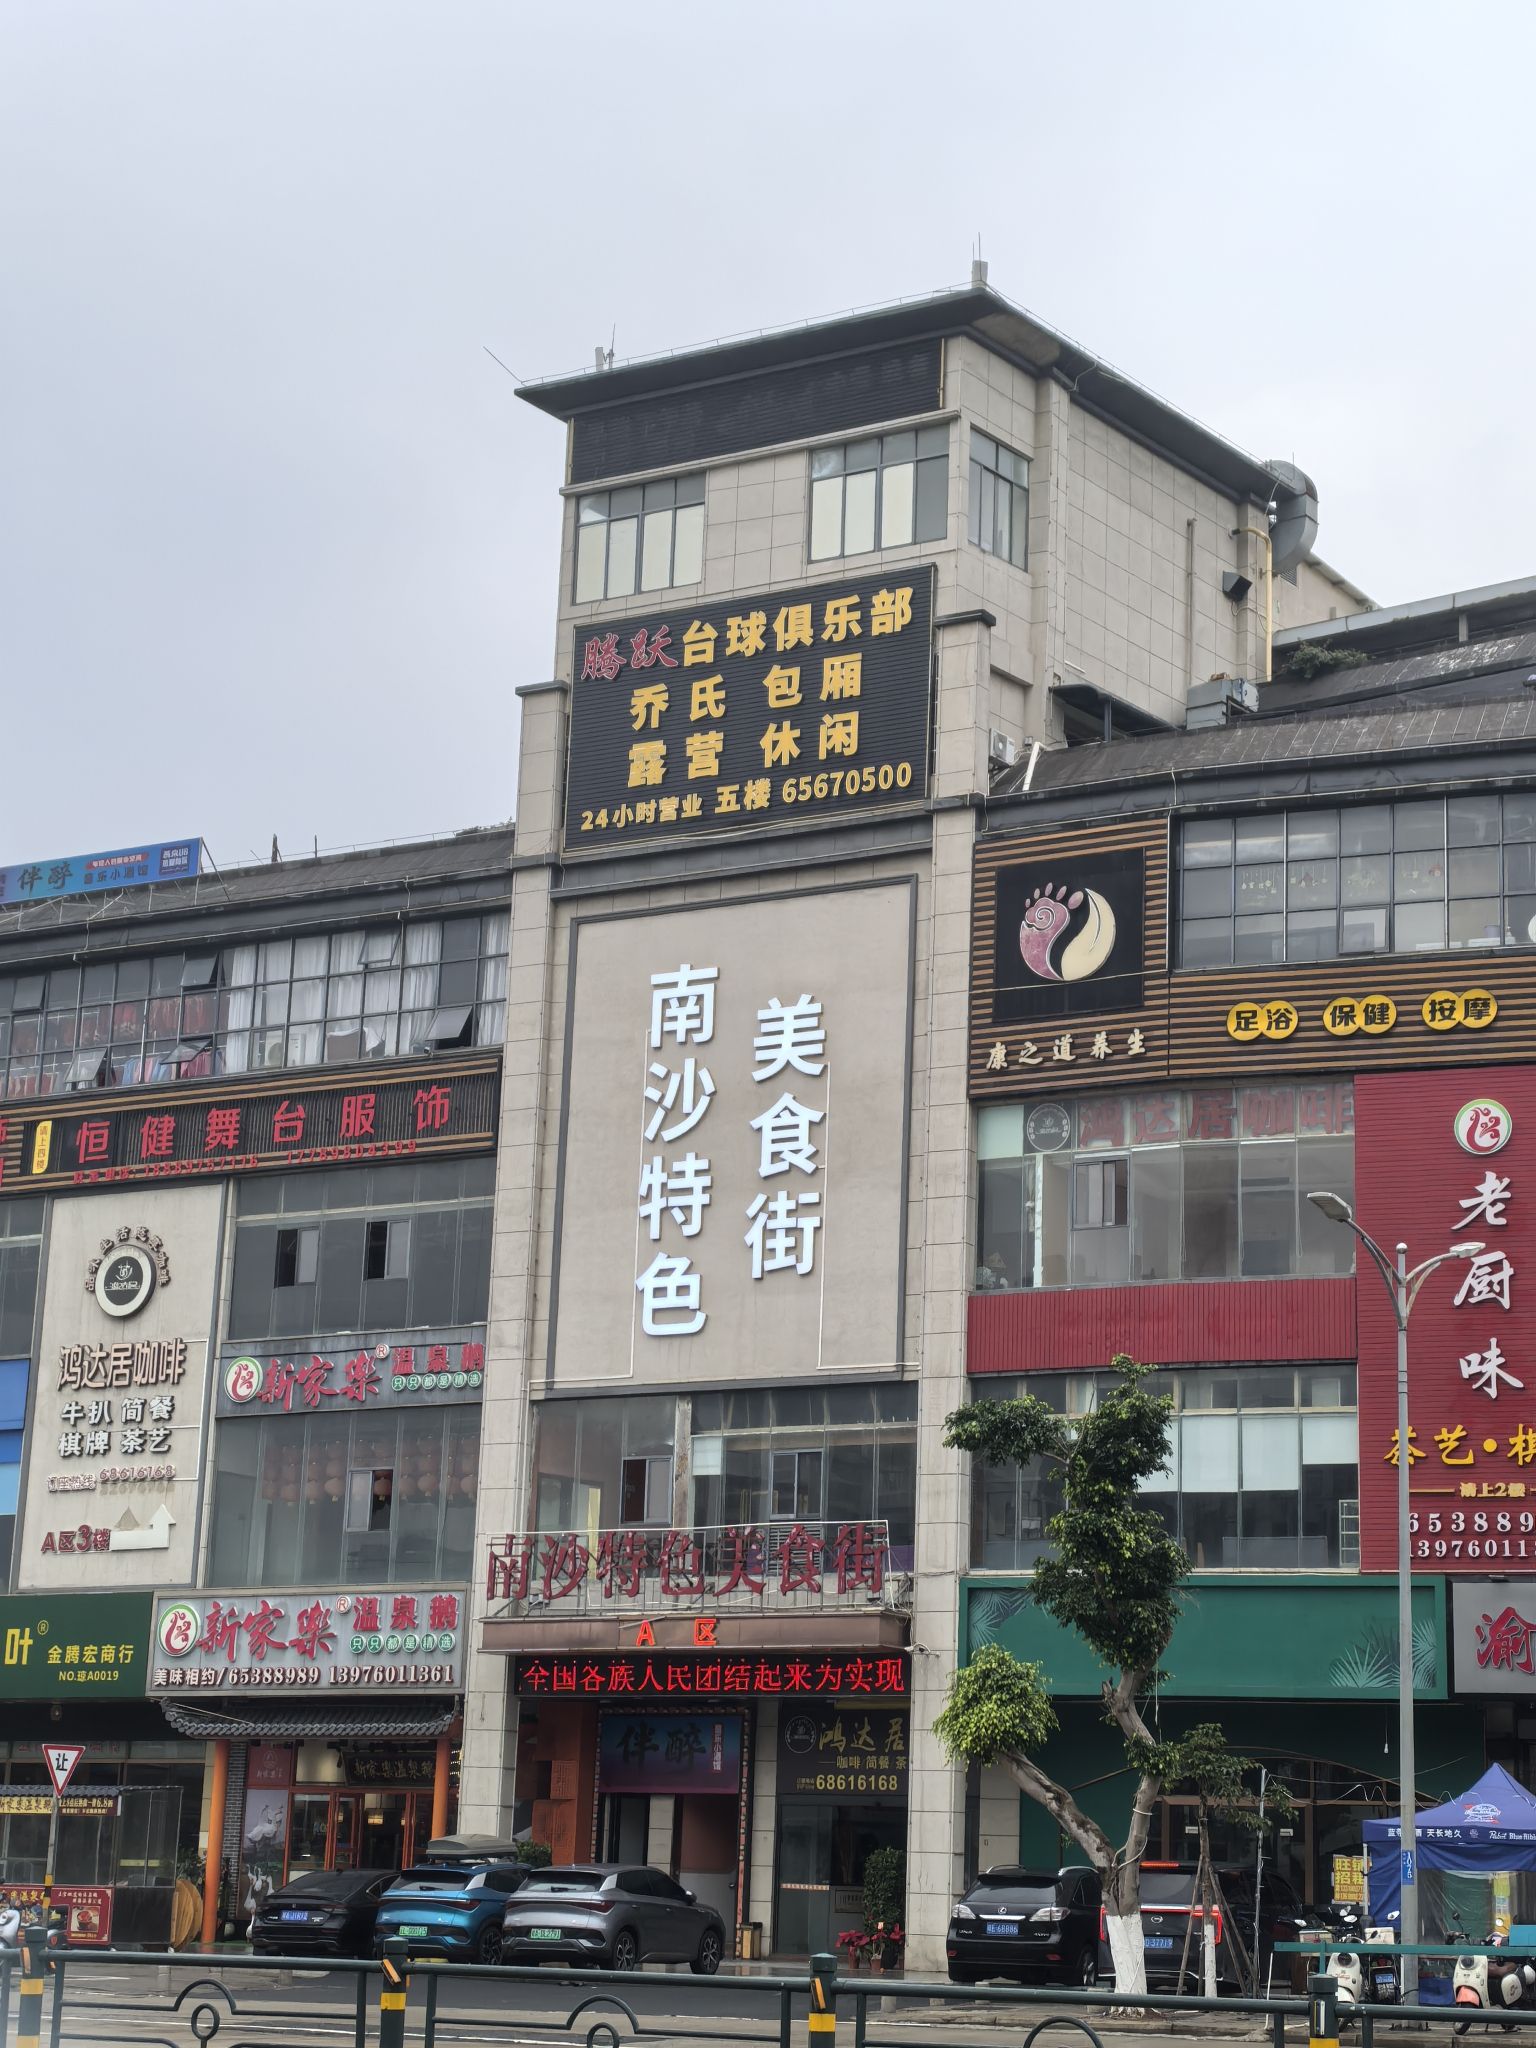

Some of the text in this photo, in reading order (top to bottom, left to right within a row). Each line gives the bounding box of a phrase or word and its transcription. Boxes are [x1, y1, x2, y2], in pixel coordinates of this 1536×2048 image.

[682, 586, 914, 667] 台球俱乐部
[629, 651, 863, 731] 乔氏 包厢
[627, 710, 861, 788] 露营 休闲
[580, 760, 913, 832] 24小时营业 五楼 65670500
[1234, 997, 1492, 1033] 足浴 保健 按摩
[986, 1028, 1147, 1071] 康之道养生
[75, 1084, 451, 1164] 恒健舞台服饰
[743, 993, 827, 1281] 美食街
[634, 963, 720, 1338] 南沙特色
[1451, 1171, 1524, 1399] 老厨味
[57, 1337, 187, 1391] 鸿达居咖啡
[61, 1396, 175, 1425] 牛扒 简餐
[58, 1428, 172, 1456] 棋牌 茶艺
[99, 1465, 176, 1480] 68616168
[41, 1524, 111, 1553] A区3楼
[1410, 1539, 1536, 1558] 3976011
[486, 1523, 888, 1600] 南沙特色美食街
[48, 1644, 134, 1664] 金腾宏商行
[350, 1633, 455, 1653] 只只都是精选
[228, 1665, 319, 1685] 65388989
[328, 1664, 452, 1684] 13976011361
[819, 1717, 906, 1752] 鸿达居
[55, 1753, 69, 1771] 让
[836, 1756, 861, 1769] 咖啡
[816, 1774, 898, 1790] 68616168
[1427, 1829, 1462, 1838] 天长地久
